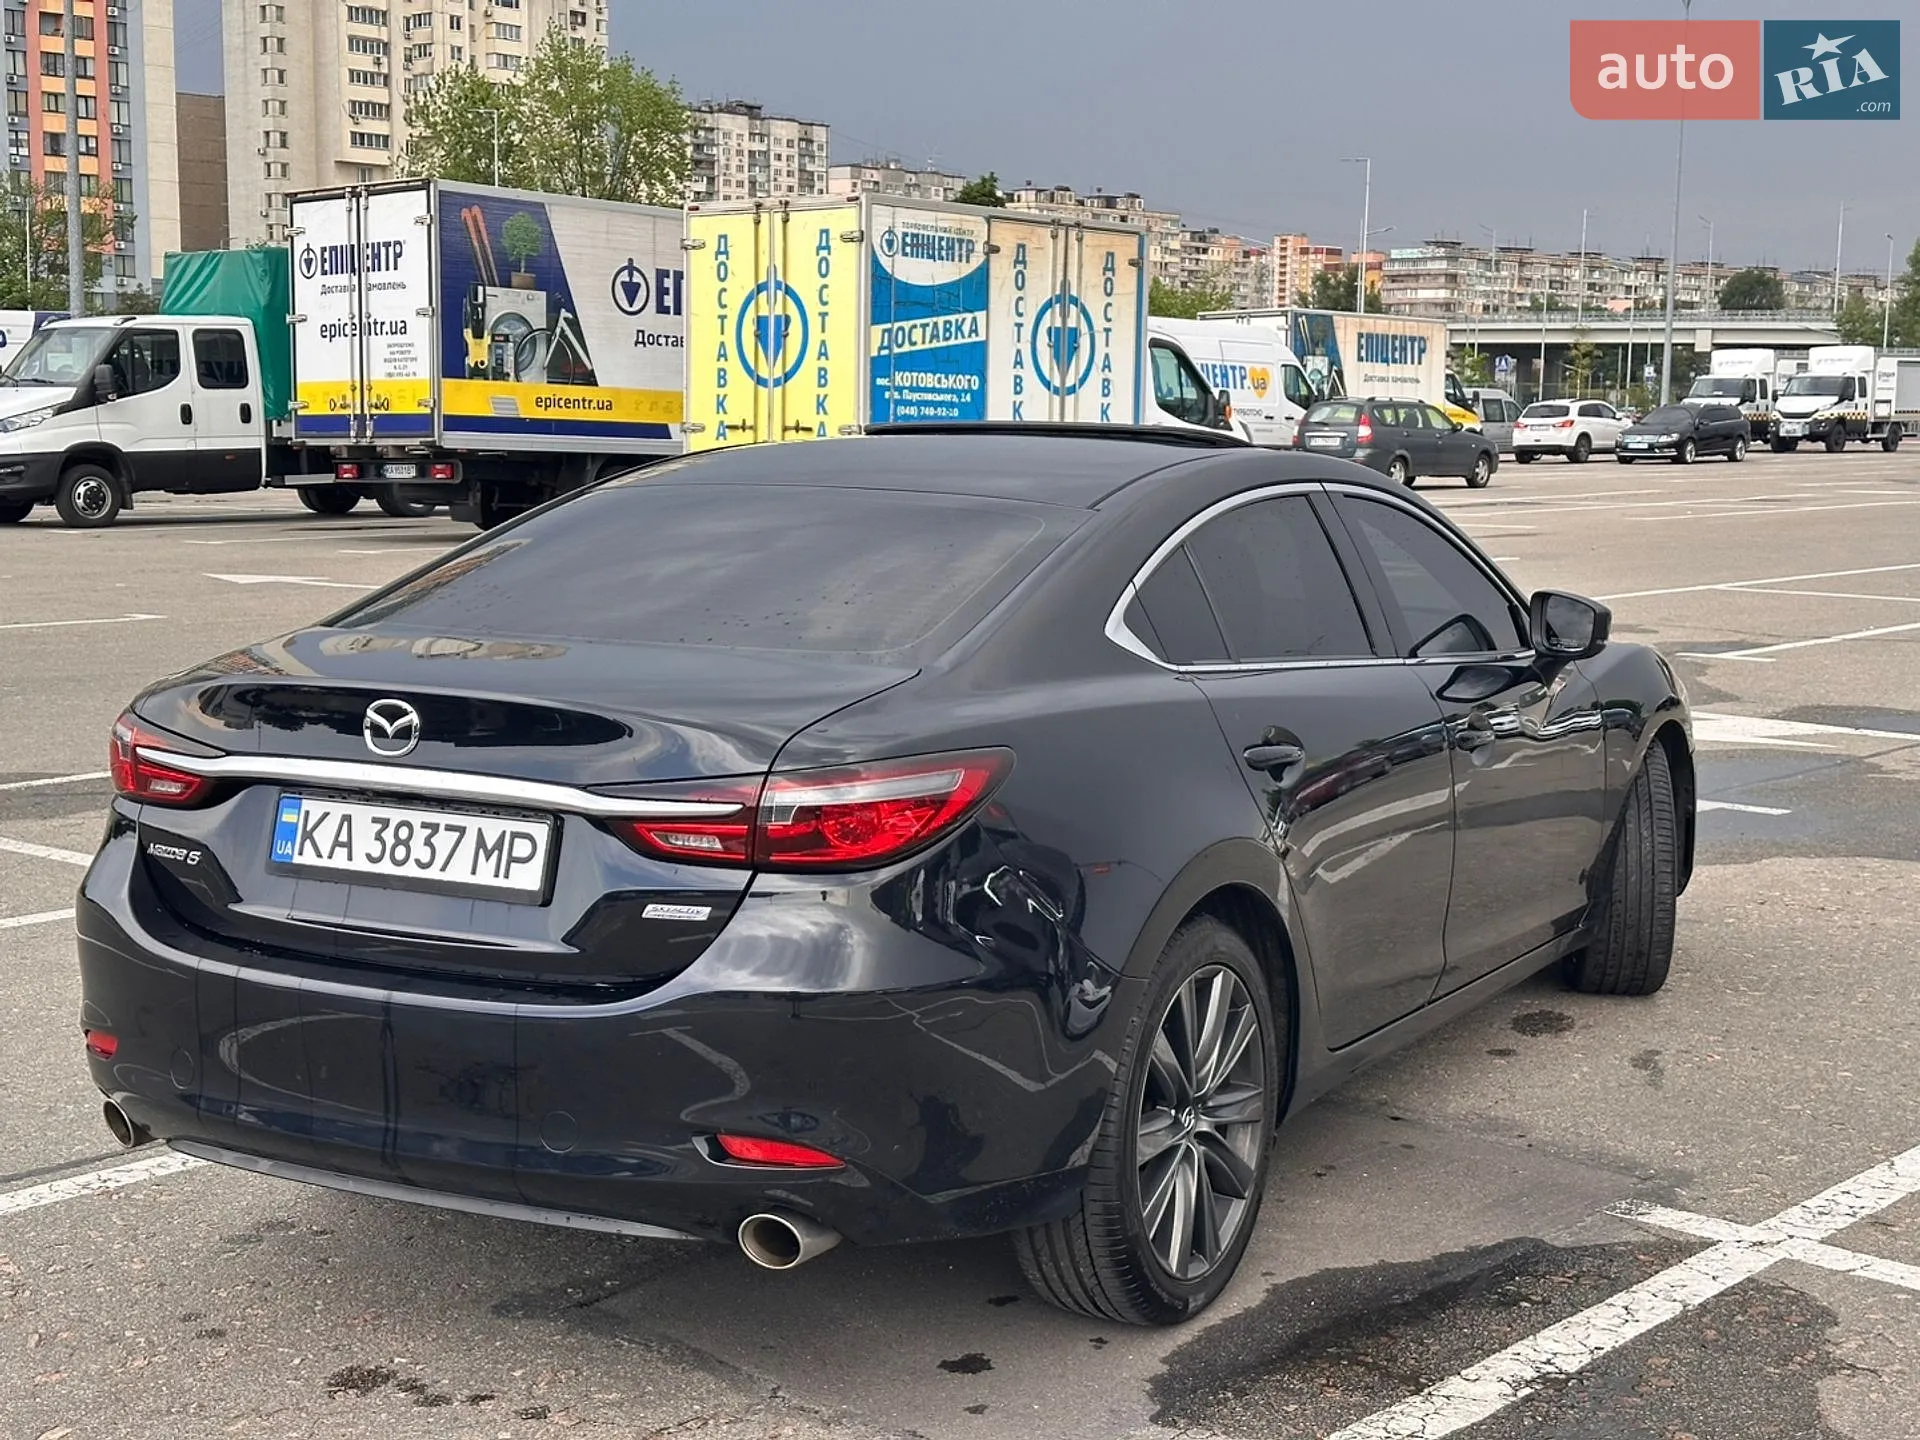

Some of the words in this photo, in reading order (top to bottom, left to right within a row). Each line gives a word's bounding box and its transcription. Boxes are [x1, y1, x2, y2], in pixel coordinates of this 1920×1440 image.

[715, 233, 730, 441] ДОСТАВКА
[877, 316, 980, 356] ДОСТАВКА
[1013, 243, 1028, 421] ДОСТАВК
[1100, 251, 1115, 423] ДОСТАВК
[1357, 332, 1427, 367] ЕПІЦЕНТР
[894, 371, 980, 391] КОТОВСЬКОГО
[535, 393, 613, 411] epicentr.ua
[276, 845, 292, 856] UA
[298, 809, 354, 862] KA
[364, 815, 467, 873] 3837
[470, 826, 537, 880] MP
